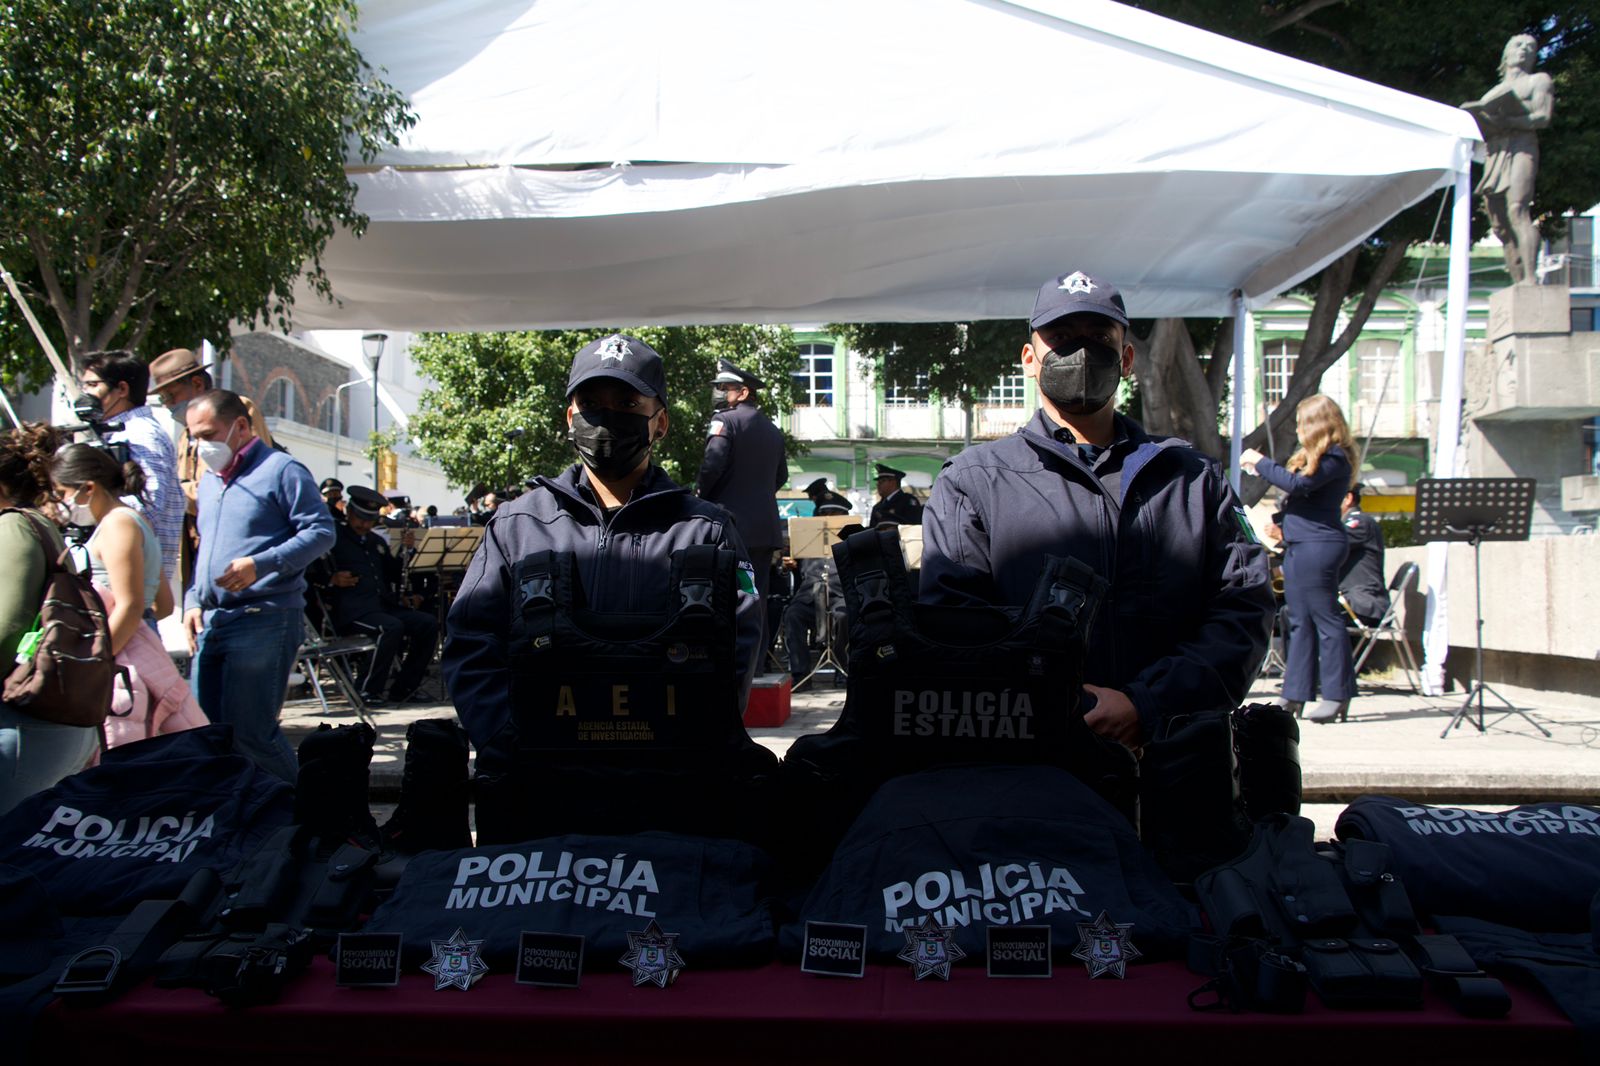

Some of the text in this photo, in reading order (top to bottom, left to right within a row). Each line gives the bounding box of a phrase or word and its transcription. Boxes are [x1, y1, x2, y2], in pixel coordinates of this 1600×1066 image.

[893, 688, 1035, 717] POLICÍA
[616, 720, 651, 731] ESTATAL
[893, 712, 1036, 740] ESTATAL
[577, 731, 590, 741] DE
[41, 804, 215, 845] POLICÍA
[453, 851, 660, 894] POLICÍA
[882, 861, 1086, 919] POLICÍA
[444, 878, 657, 918] MUNICIPAL
[809, 937, 862, 950] PROXIMIDAD
[992, 941, 1046, 950] PROXIMIDAD
[342, 949, 396, 958] PROXIMIDAD
[524, 947, 578, 959] PROXIMIDAD
[808, 945, 861, 961] SOCIAL
[992, 949, 1047, 962] SOCIAL
[342, 957, 396, 969] SOCIAL
[523, 955, 577, 971] SOCIAL
